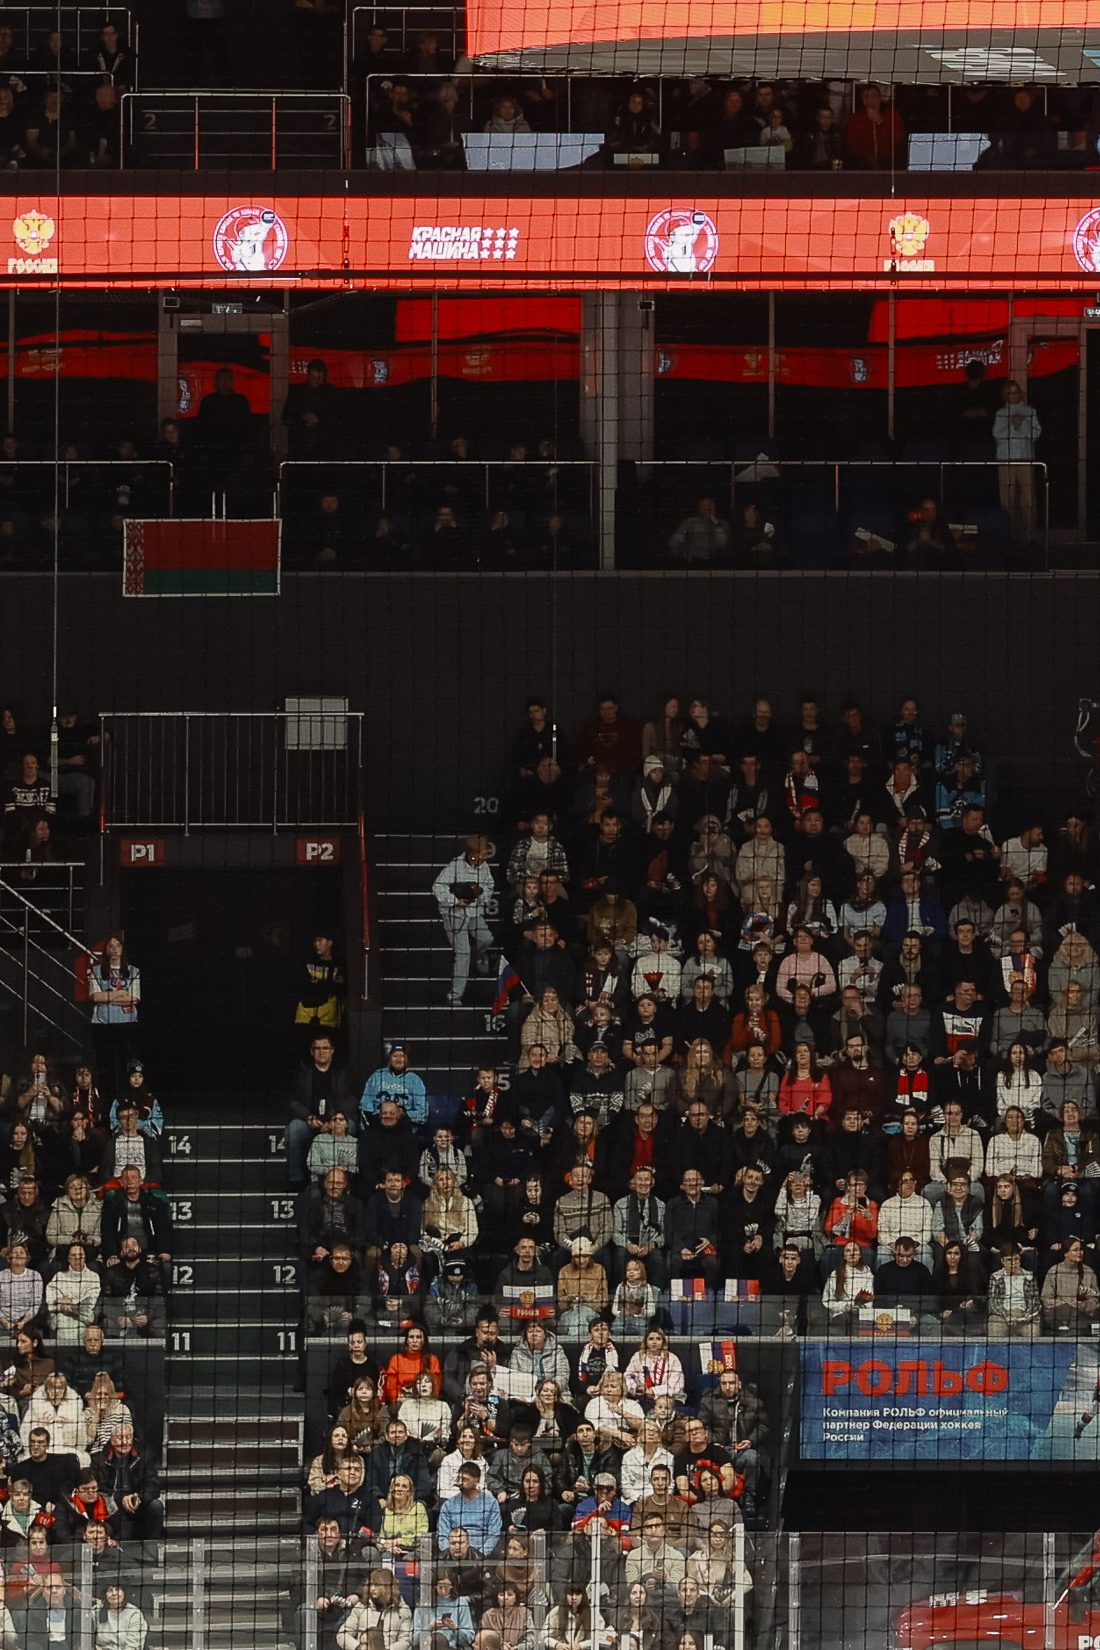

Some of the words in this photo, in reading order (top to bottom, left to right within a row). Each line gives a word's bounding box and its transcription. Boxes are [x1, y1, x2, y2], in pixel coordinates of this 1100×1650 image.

[143, 113, 158, 130] 2
[323, 113, 338, 130] 2
[411, 227, 482, 242] КРАСНАЯ
[408, 242, 480, 260] МАШИНА
[474, 797, 499, 814] 20
[131, 844, 155, 862] P1
[305, 843, 333, 860] P2
[484, 1015, 506, 1033] 16
[169, 1135, 191, 1153] 14
[170, 1202, 192, 1220] 13
[271, 1200, 295, 1219] 13
[173, 1266, 194, 1285] 12
[273, 1266, 296, 1284] 12
[172, 1333, 190, 1351] 11
[277, 1332, 296, 1350] 11
[822, 1359, 1009, 1396] РОЛЬФ
[823, 1408, 880, 1418] Компания
[883, 1408, 926, 1417] РОЛЬФ
[872, 1420, 938, 1431] Федерации
[940, 1422, 981, 1430] хоккея
[823, 1433, 865, 1442] России
